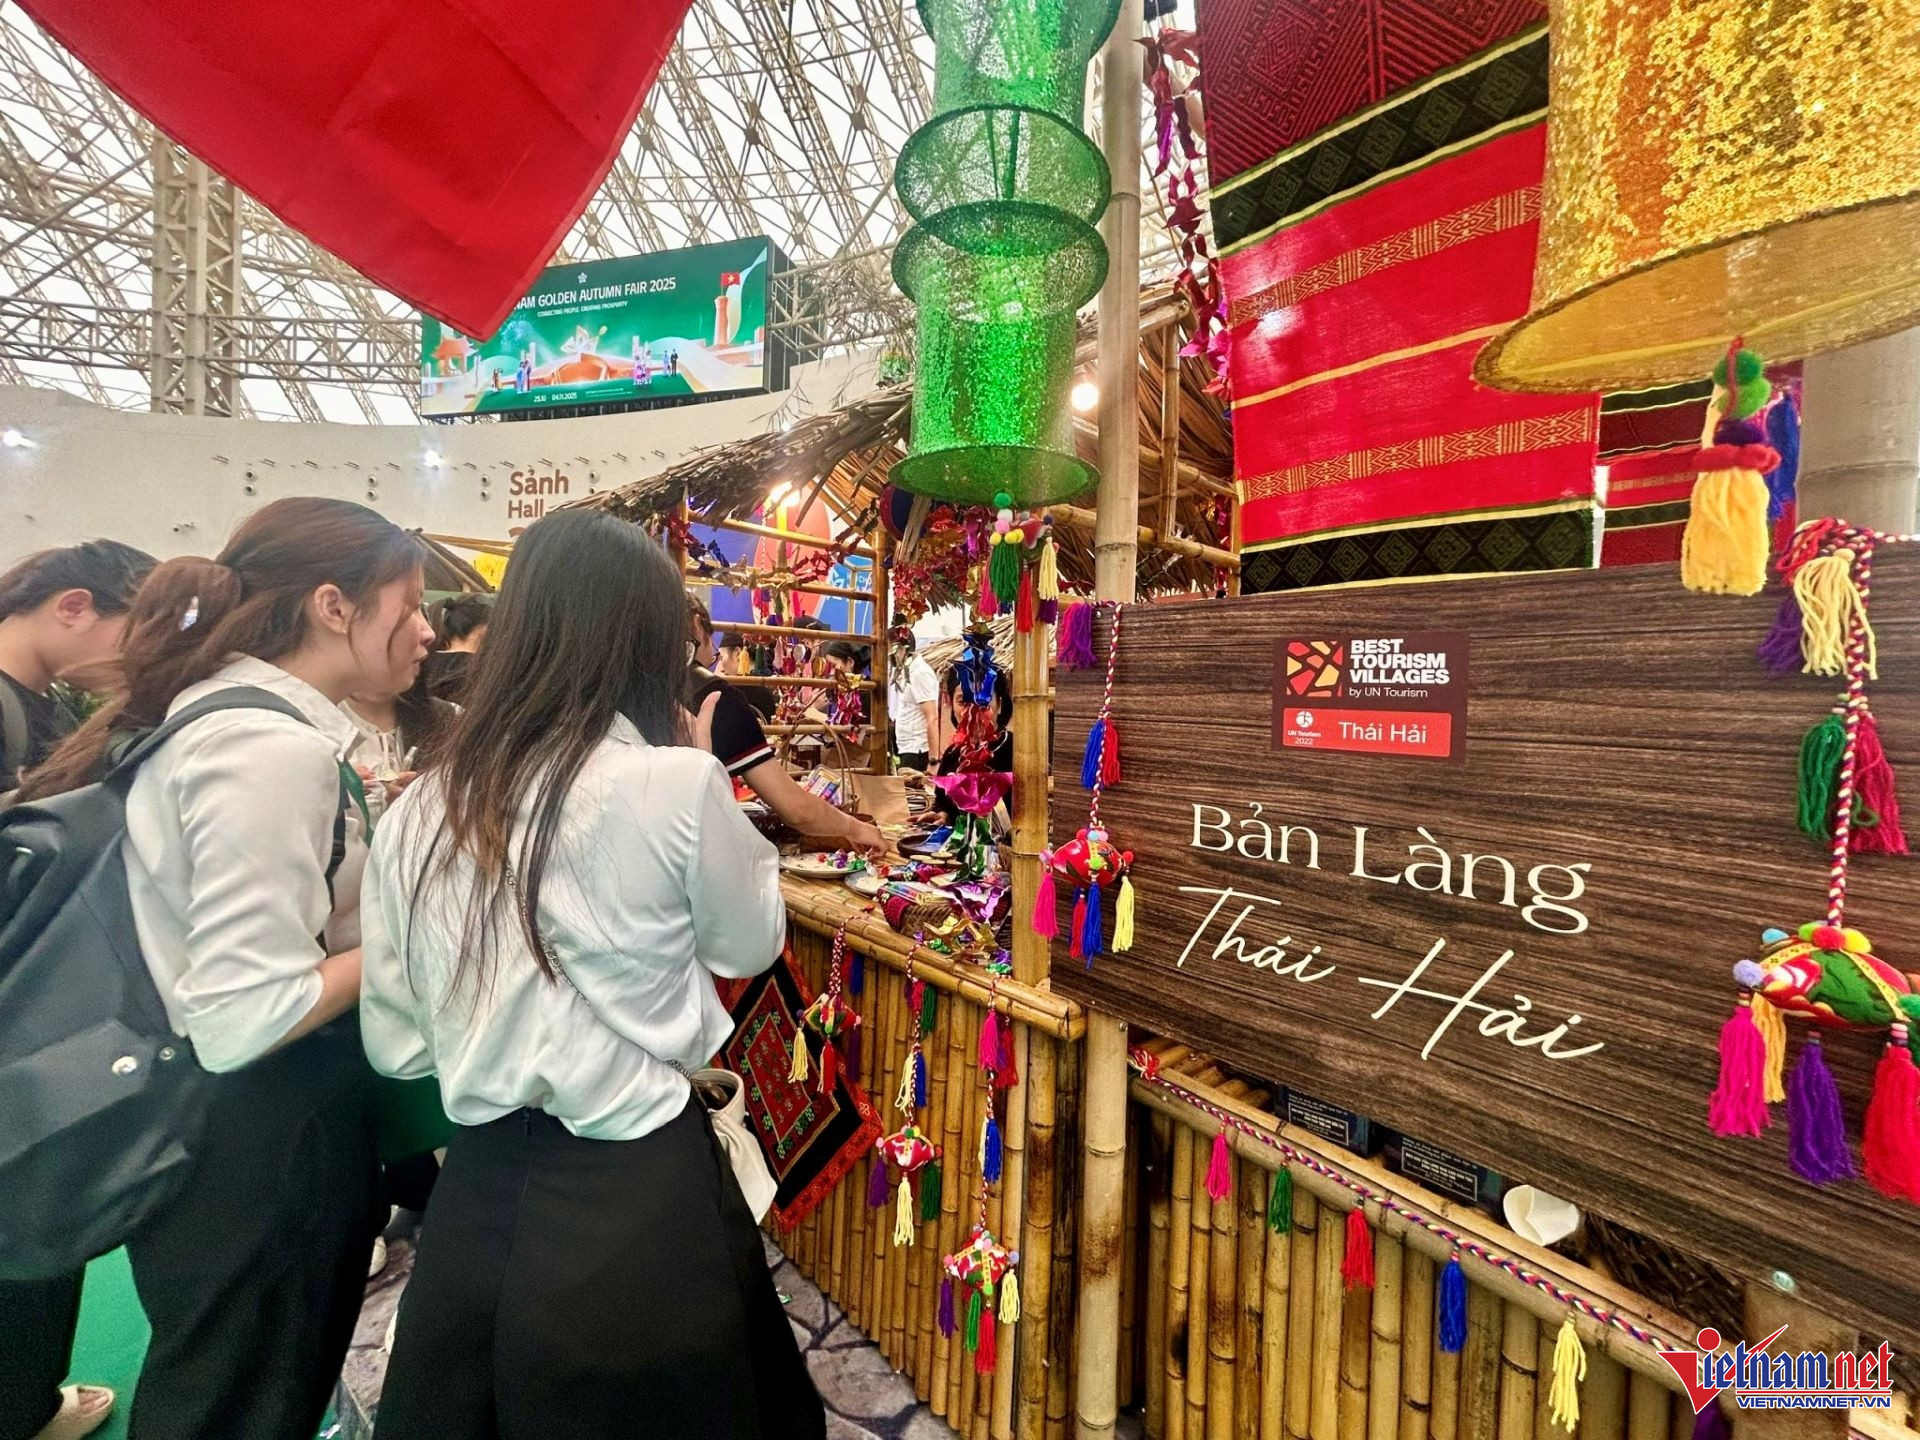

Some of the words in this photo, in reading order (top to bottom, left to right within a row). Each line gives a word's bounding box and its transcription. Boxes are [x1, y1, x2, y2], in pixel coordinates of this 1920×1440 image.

[538, 290, 577, 308] GOLDEN
[579, 284, 622, 302] AUTUMN
[624, 281, 647, 296] FAIR
[649, 276, 677, 292] 2025
[509, 468, 569, 496] Sảnh
[507, 498, 544, 519] Hall
[1351, 639, 1404, 654] BEST
[1350, 653, 1446, 669] TOURISM
[1350, 669, 1450, 684] VILLAGES
[1349, 687, 1361, 699] by
[1364, 687, 1381, 697] UN
[1384, 687, 1428, 698] Tourism
[1295, 737, 1313, 745] 2022
[1338, 721, 1383, 741] Thái
[1390, 723, 1428, 744] Hải
[1190, 801, 1322, 870] Bản
[1348, 826, 1592, 935] Làng
[1176, 886, 1336, 982] Thái
[1357, 937, 1605, 1061] Hải
